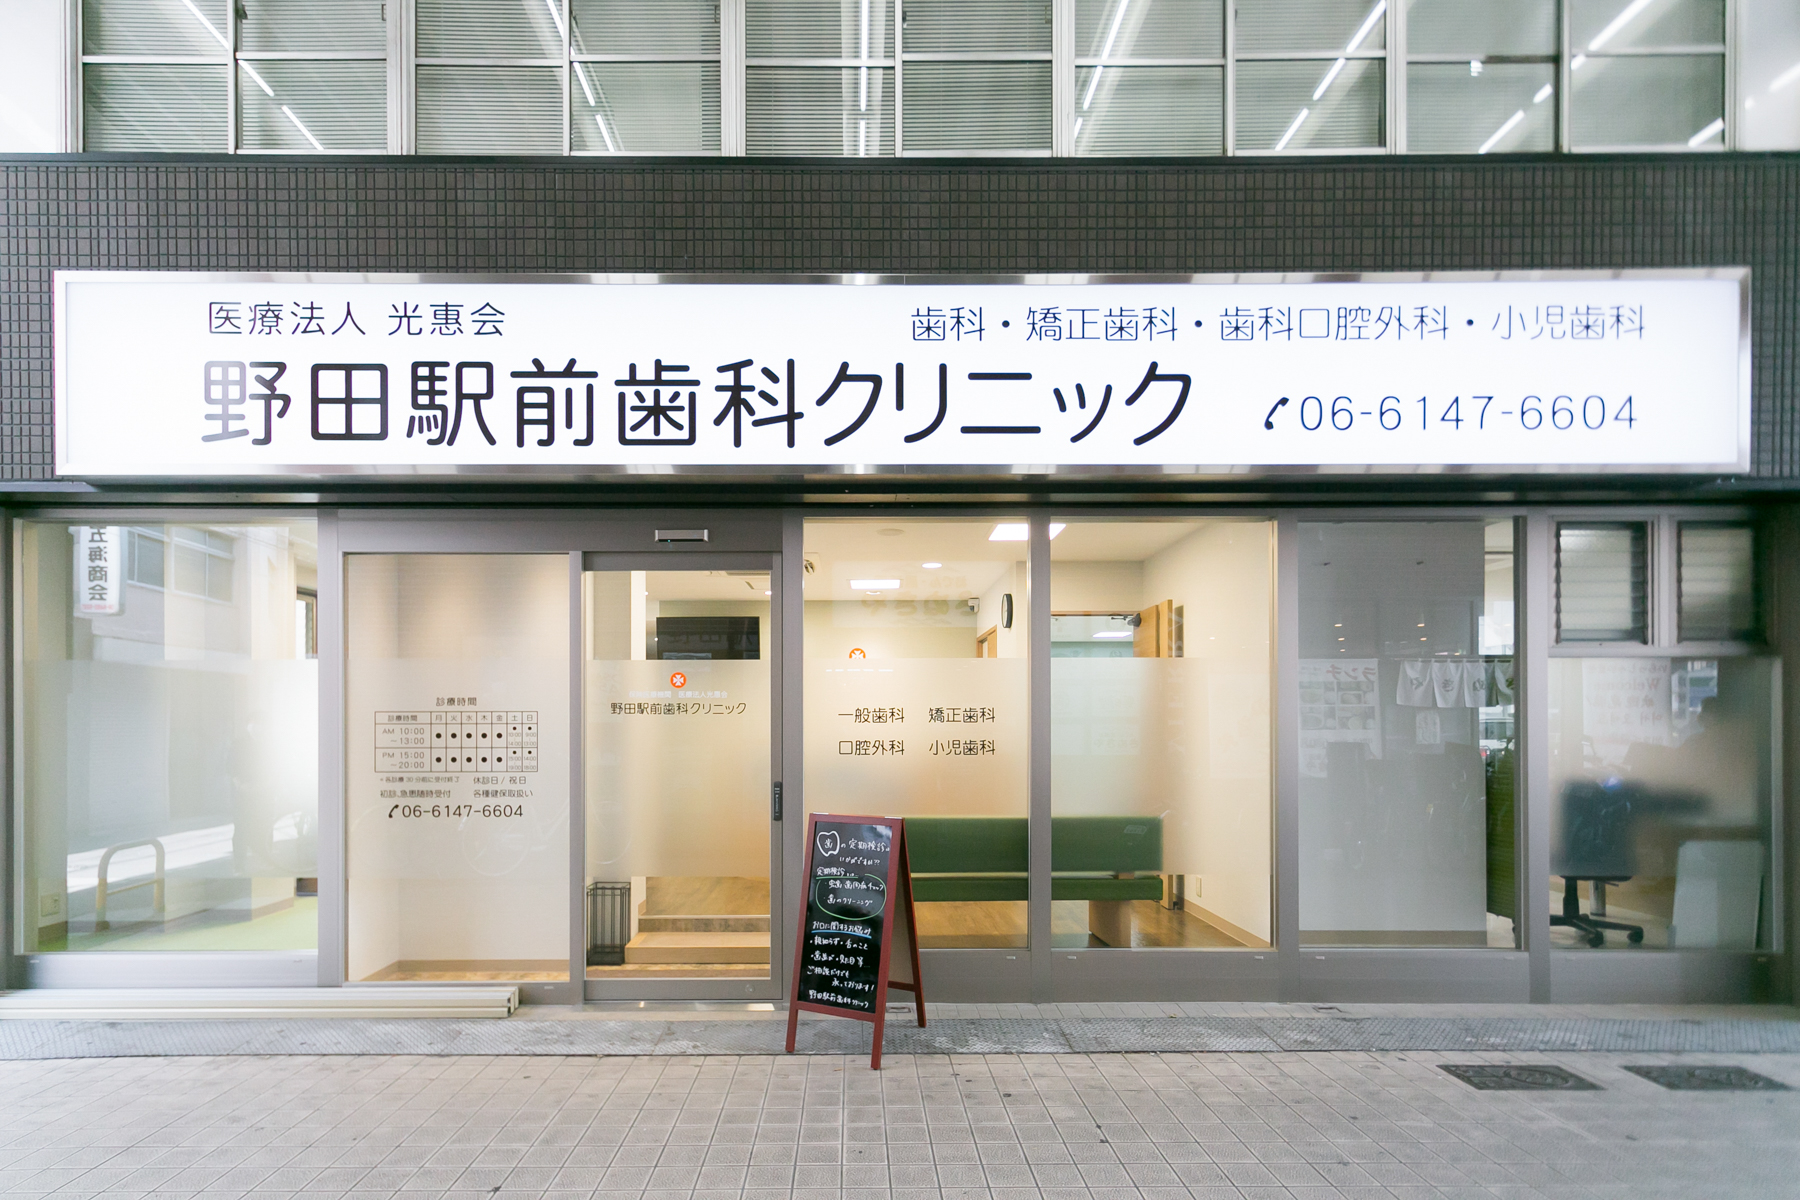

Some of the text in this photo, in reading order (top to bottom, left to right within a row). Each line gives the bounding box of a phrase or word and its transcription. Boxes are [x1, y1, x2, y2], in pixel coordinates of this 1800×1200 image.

[208, 300, 366, 336] 医療法人
[910, 303, 1646, 342] 歯科・矯正歯科・歯科口腔外科・小児歯科
[202, 357, 1193, 449] 野田駅前歯科クリニック
[1300, 394, 1638, 432] 06-6147-6604
[435, 696, 477, 707] 診療時間
[610, 702, 747, 716] 野田駅前歯科クリニック
[434, 714, 443, 722] 月
[450, 714, 458, 722] 火
[465, 714, 473, 722] 水
[480, 714, 488, 722] 木
[496, 714, 503, 722] 金
[511, 714, 518, 722] 土
[526, 714, 533, 722] 日
[838, 706, 996, 724] 一般歯科 矯正歯科
[399, 727, 425, 736] 10:00
[399, 751, 425, 760] 15:00
[838, 739, 996, 756] 口腔外科 小児歯科
[401, 804, 524, 819] 06-6147-6604
